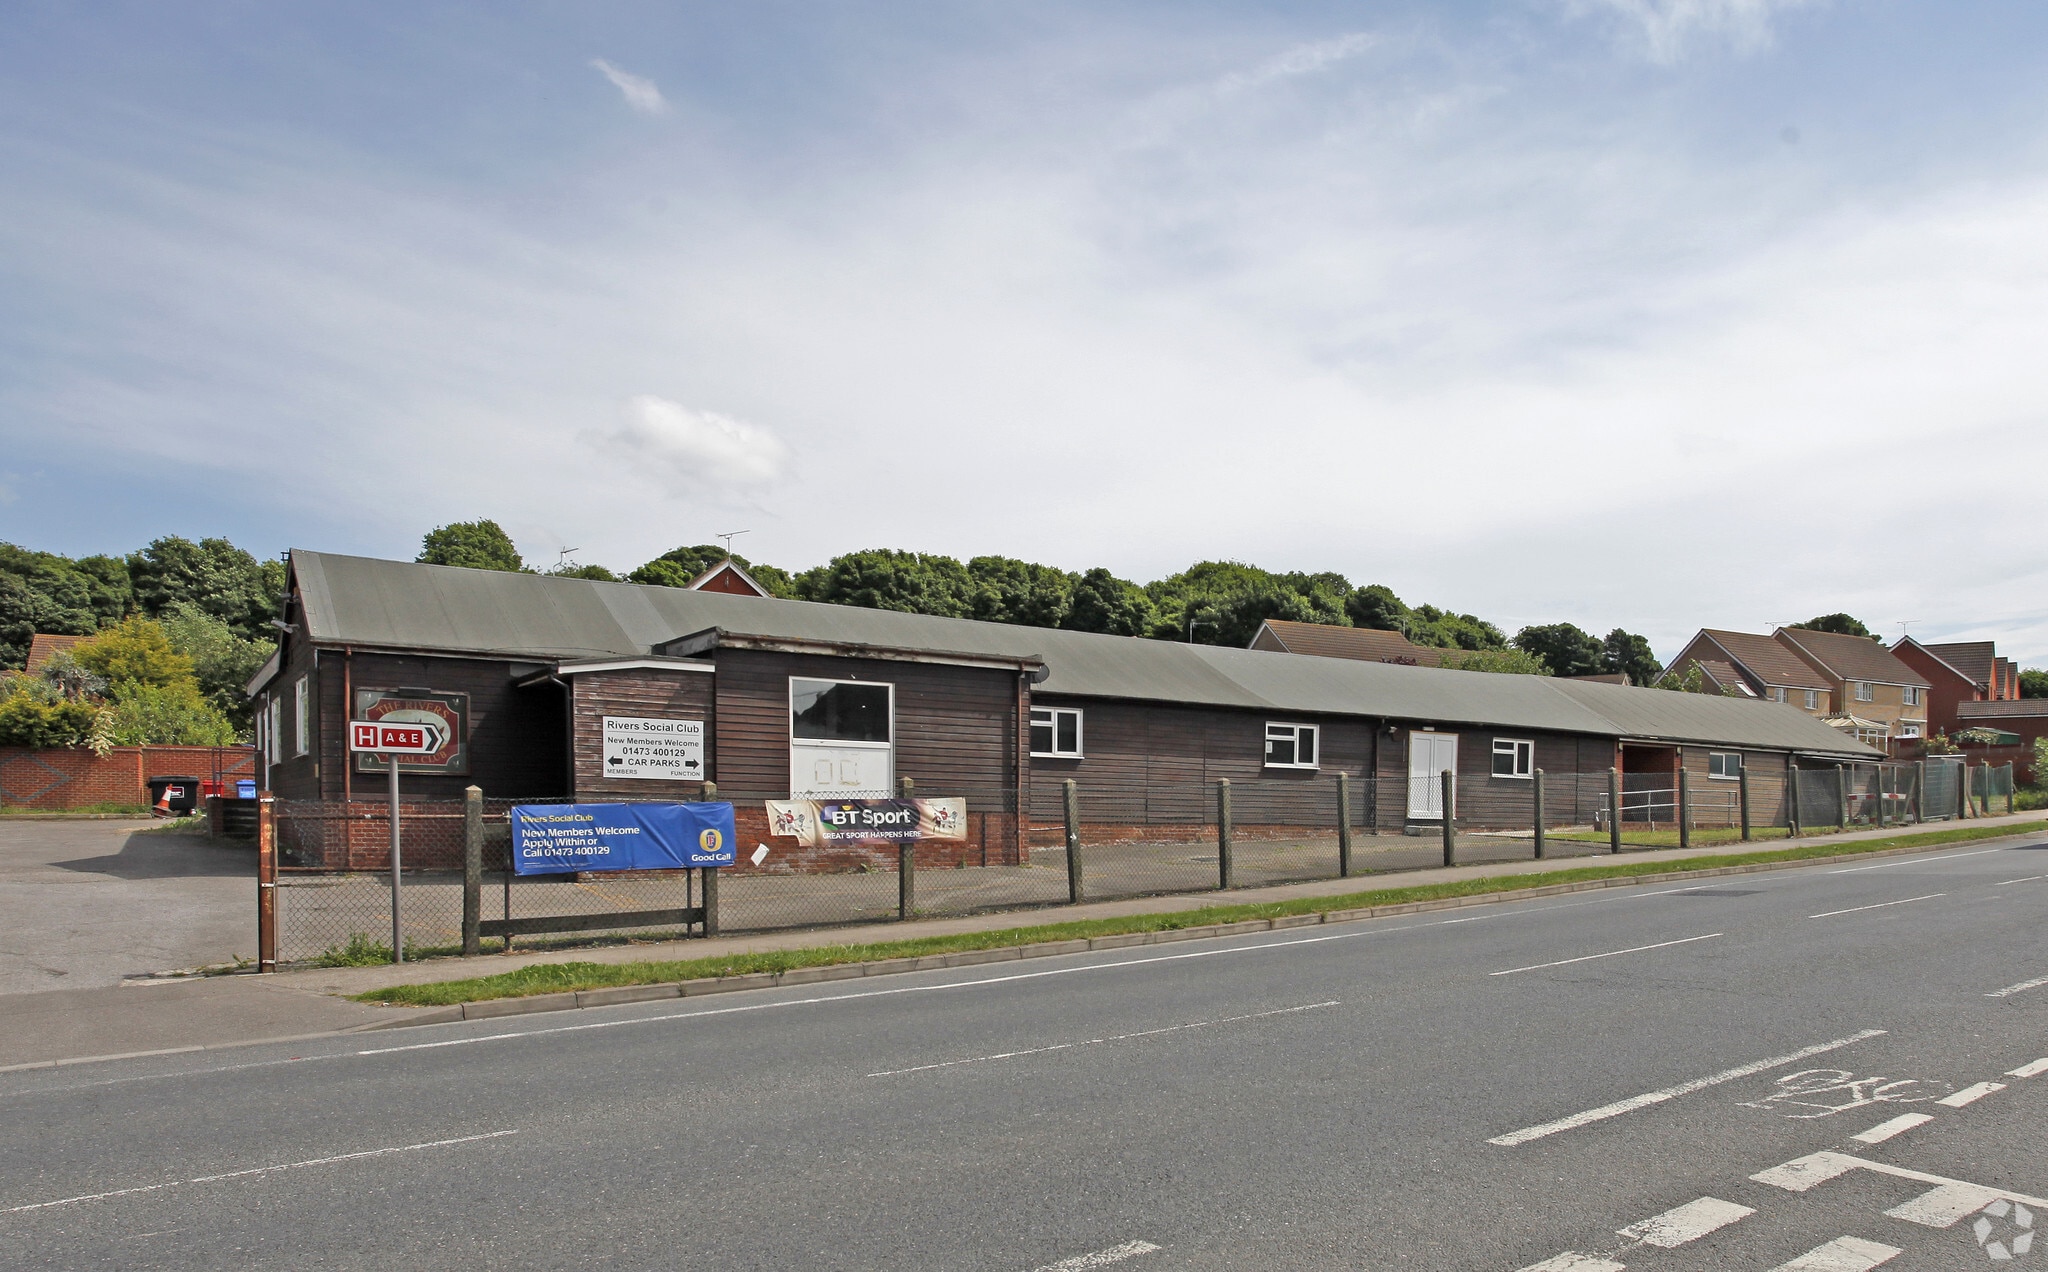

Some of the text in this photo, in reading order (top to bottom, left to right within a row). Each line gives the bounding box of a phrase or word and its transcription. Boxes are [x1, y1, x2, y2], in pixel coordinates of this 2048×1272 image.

[376, 701, 450, 719] THE RIVERS
[607, 721, 700, 733] Rivers Social Club
[358, 728, 374, 746] H
[386, 732, 419, 743] A & E
[607, 736, 700, 747] New Members Welcome
[420, 751, 447, 763] CLUB
[622, 747, 686, 757] 01473 400129
[628, 758, 648, 766] CAR
[549, 814, 574, 822] Social
[574, 814, 594, 822] Club
[832, 808, 911, 826] BT Sport
[522, 827, 640, 838] New Members Welcome
[846, 831, 869, 839] SPORT
[522, 839, 553, 849] Apply
[555, 838, 585, 846] Within
[523, 846, 610, 857] Call 01473 400129
[716, 853, 731, 861] Call
